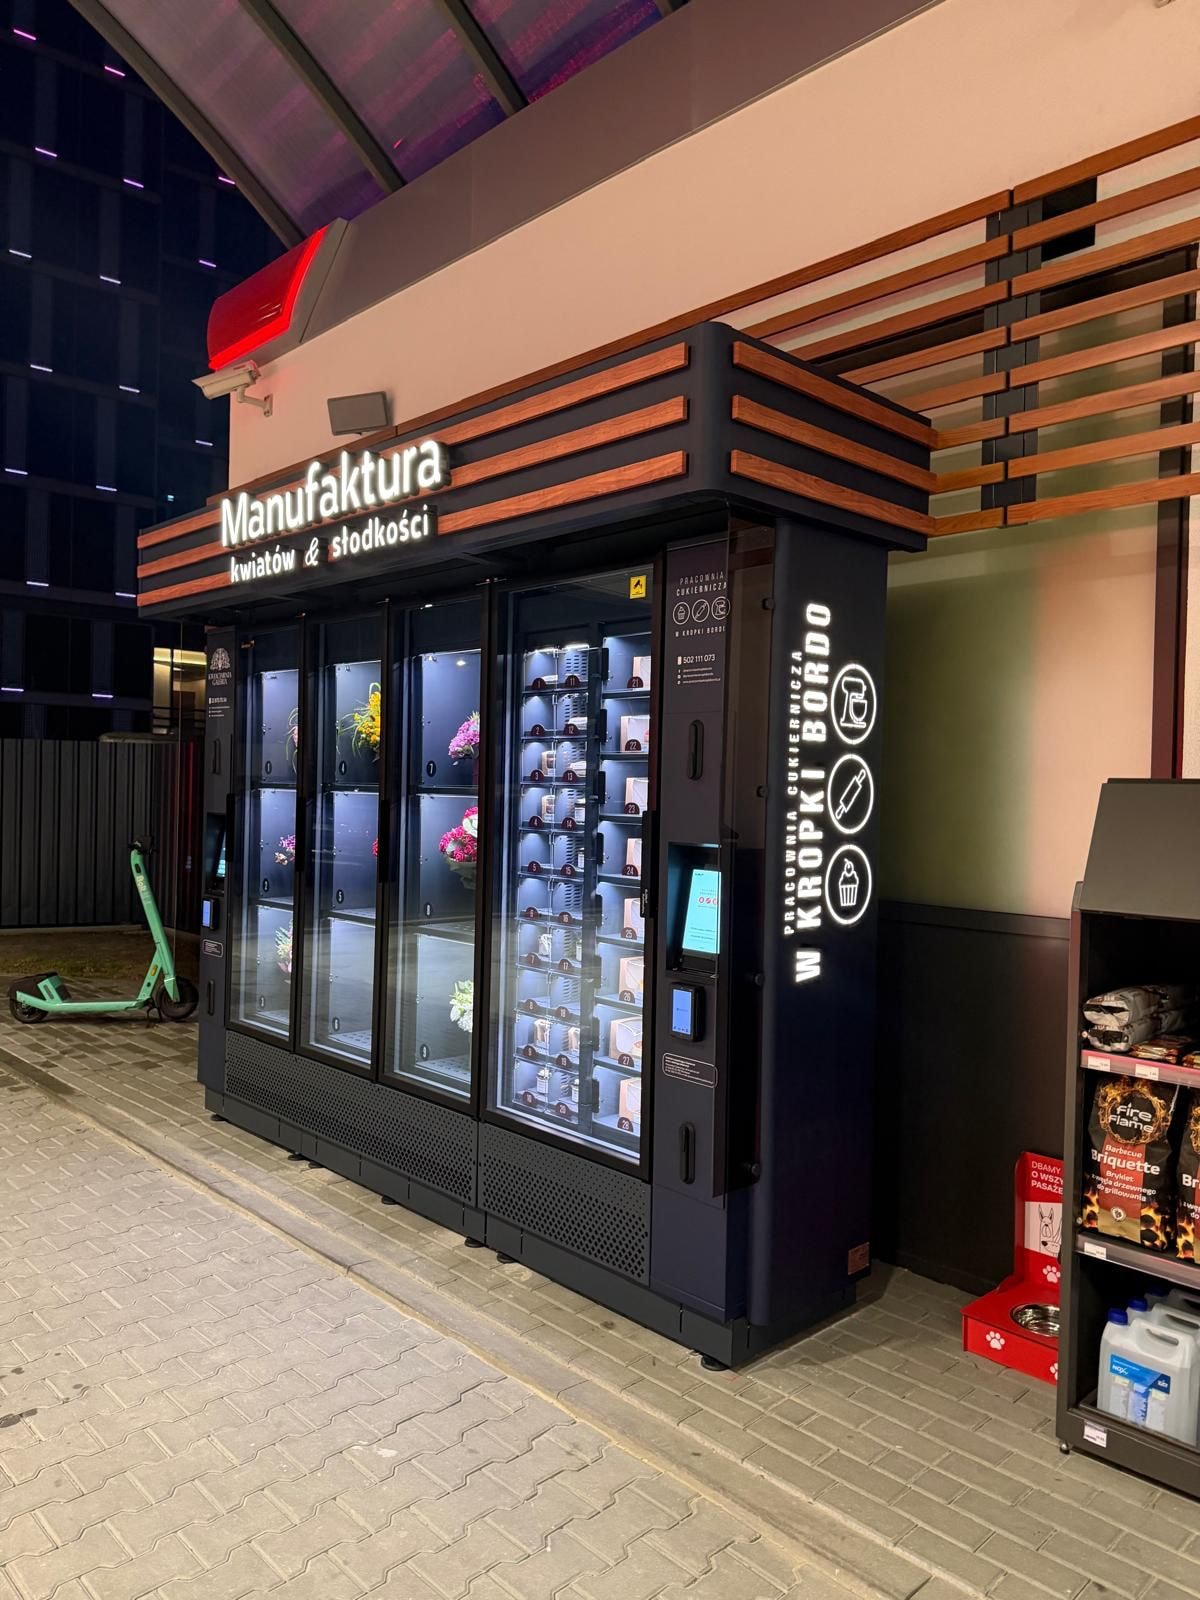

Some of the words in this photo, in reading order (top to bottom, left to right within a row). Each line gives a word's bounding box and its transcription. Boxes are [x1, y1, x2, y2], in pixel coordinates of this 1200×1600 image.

[221, 440, 442, 547] Manufaktura
[231, 545, 296, 583] kwiatów
[305, 537, 319, 566] &
[332, 504, 429, 558] słodkości
[680, 571, 724, 585] PRACOWNIA
[683, 656, 694, 664] 502
[695, 655, 703, 663] 111
[704, 654, 716, 662] 073
[802, 602, 832, 742] BORDO
[632, 678, 639, 687] 21
[787, 651, 802, 796] CUKIERNICZA
[629, 741, 637, 750] 22
[628, 804, 635, 813] 23
[797, 769, 826, 930] KROPKI
[627, 866, 634, 875] 24
[784, 810, 798, 935] PRACOWNIA
[626, 929, 633, 939] 25
[796, 951, 821, 983] W
[623, 1056, 630, 1065] 27
[1105, 1144, 1142, 1158] Barbecue
[1031, 1160, 1061, 1174] DBAMY
[1091, 1149, 1160, 1175] Briquette
[1106, 1170, 1135, 1182] Brykiet
[1182, 1173, 1200, 1189] Br
[1105, 1187, 1147, 1202] grillowania
[1113, 1181, 1156, 1195] drzewnego
